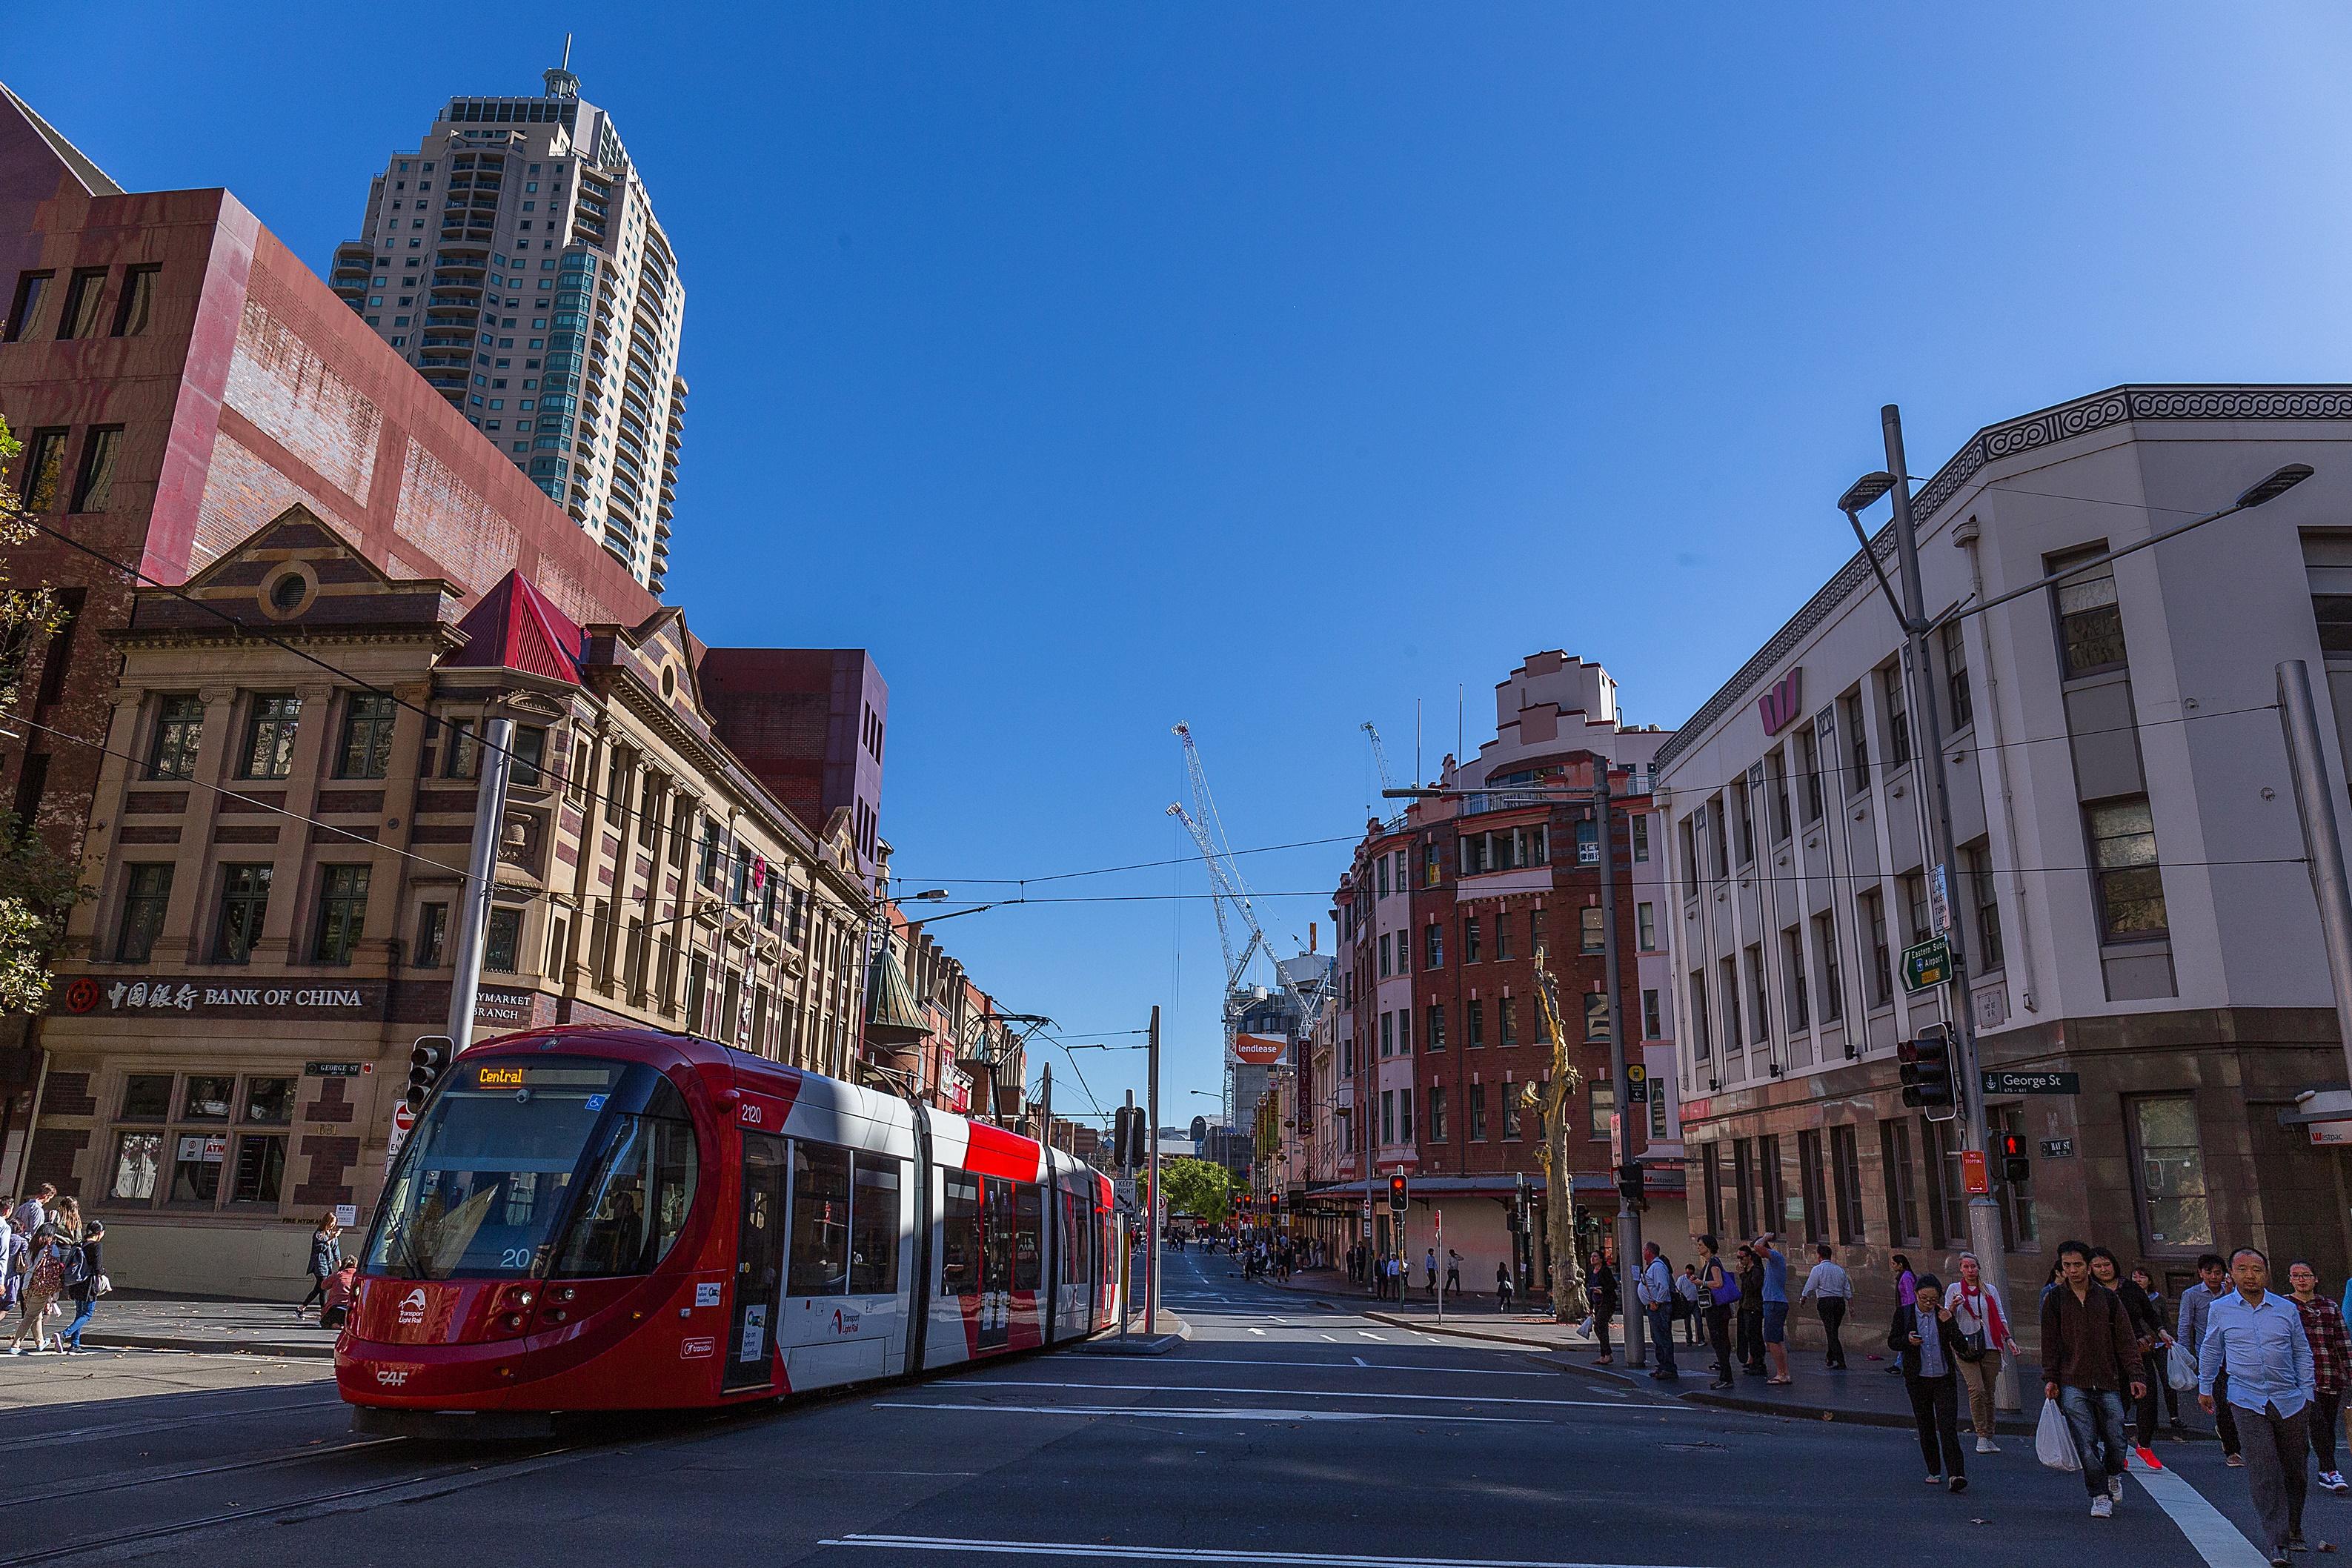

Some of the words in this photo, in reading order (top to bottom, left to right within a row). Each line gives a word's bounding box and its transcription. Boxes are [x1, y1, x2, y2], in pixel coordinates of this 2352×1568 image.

[1933, 892, 1944, 904] MUST
[1935, 905, 1947, 916] TURN
[1936, 915, 1947, 926] LEFT
[1912, 947, 1931, 960] Eastern
[1933, 941, 1945, 951] Subs
[1924, 954, 1944, 967] Airport
[203, 989, 261, 1005] BANK
[265, 989, 291, 1006] OF
[295, 989, 363, 1006] CHINA
[1238, 1044, 1277, 1052] lendlease
[479, 1069, 522, 1083] Central
[2003, 1074, 2046, 1089] George
[2049, 1074, 2061, 1086] St
[743, 1104, 761, 1123] 2120
[2312, 1132, 2342, 1142] Westpac
[206, 1145, 225, 1153] ATM
[2051, 1142, 2061, 1150] HAY
[2063, 1141, 2069, 1149] ST
[499, 1248, 530, 1268] 20
[376, 1371, 408, 1386] CAF
